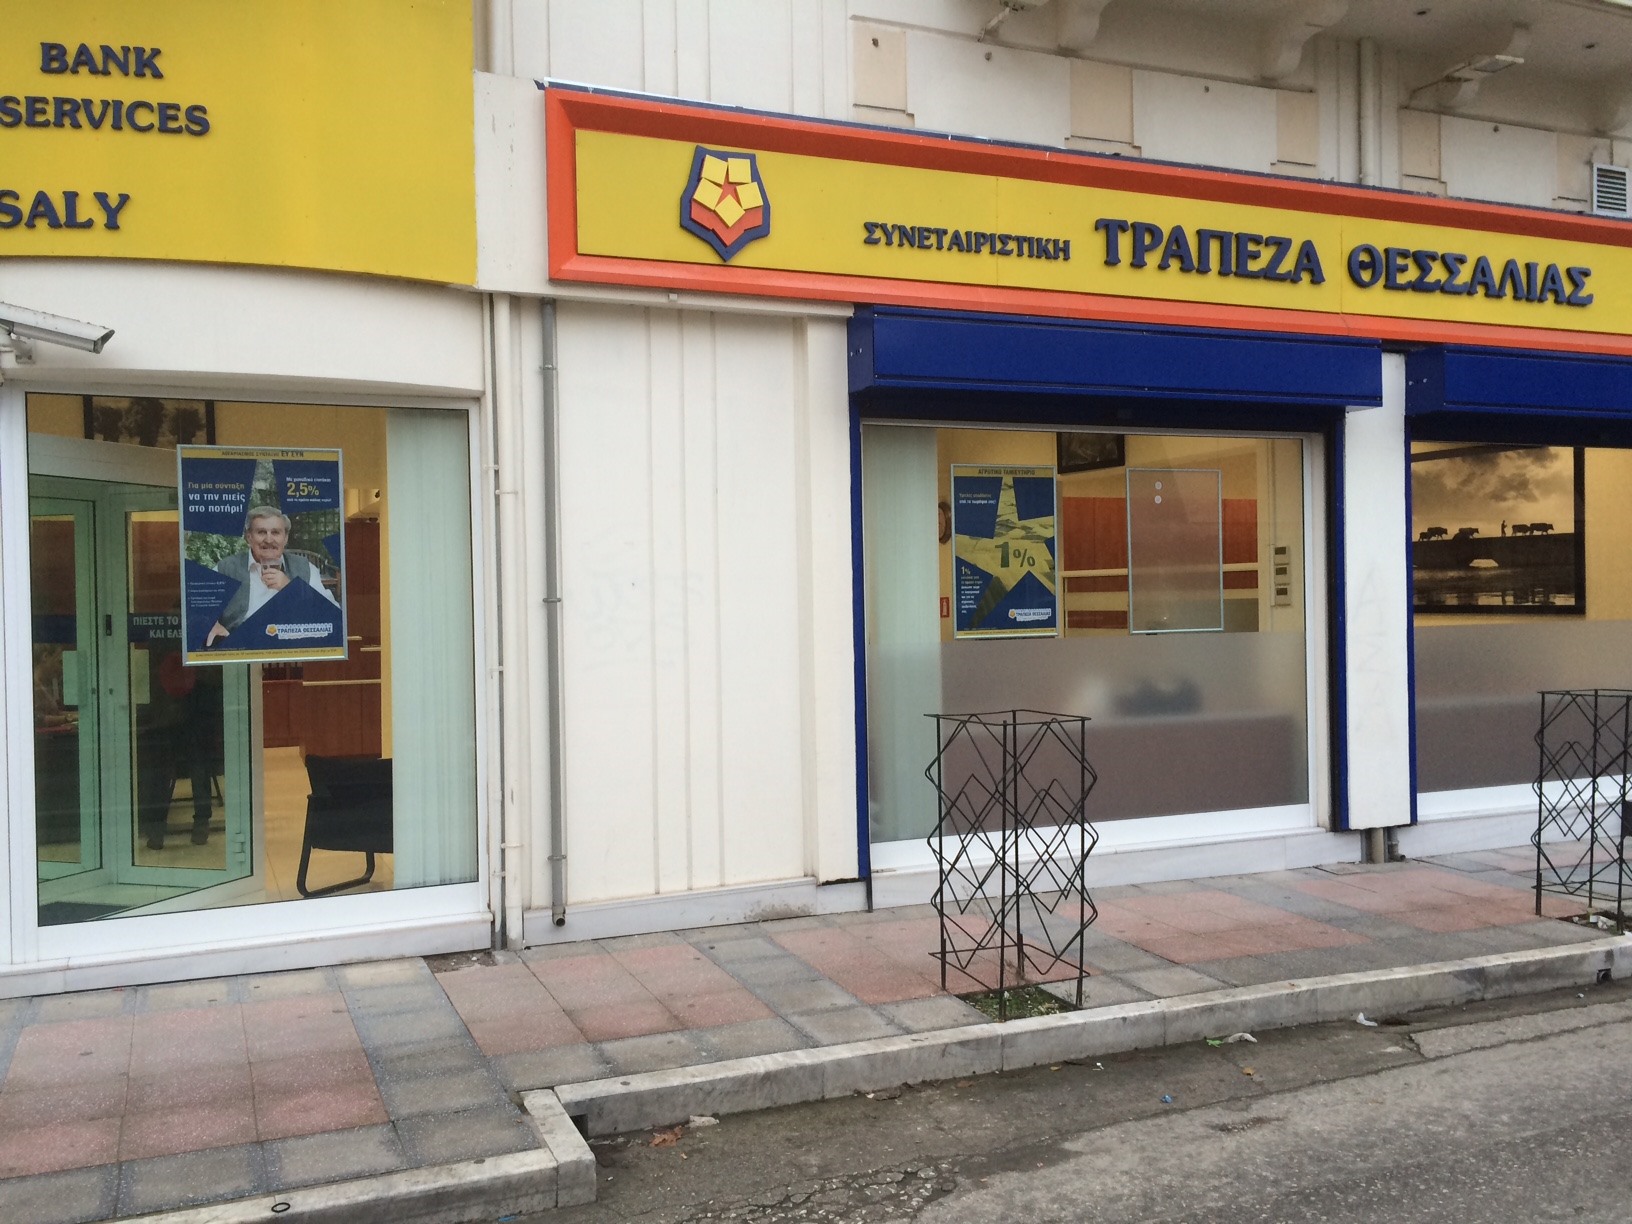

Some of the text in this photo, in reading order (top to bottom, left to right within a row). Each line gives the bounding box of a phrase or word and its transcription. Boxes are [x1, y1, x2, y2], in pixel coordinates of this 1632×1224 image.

[40, 42, 164, 79] BANK
[0, 95, 210, 136] SERVICES
[0, 189, 130, 230] SALY
[863, 218, 1594, 306] ΣΥΝΕΤΑΙΡΙΣΤΙΚΗ ΤΡΑΠΕΖΑ ΘΕΣΣΑΛΙΑΣ
[201, 482, 213, 490] μία
[215, 482, 245, 491] σύνταξη
[286, 482, 320, 497] 2,5%
[188, 492, 246, 502] να την πιείς
[188, 504, 243, 514] στο ποτήρι!
[994, 541, 1036, 568] 1%
[960, 566, 971, 575] 1%
[133, 616, 179, 626] ΠΙΕΣΤΕ ΤΟ
[149, 629, 165, 638] ΚΑΙ
